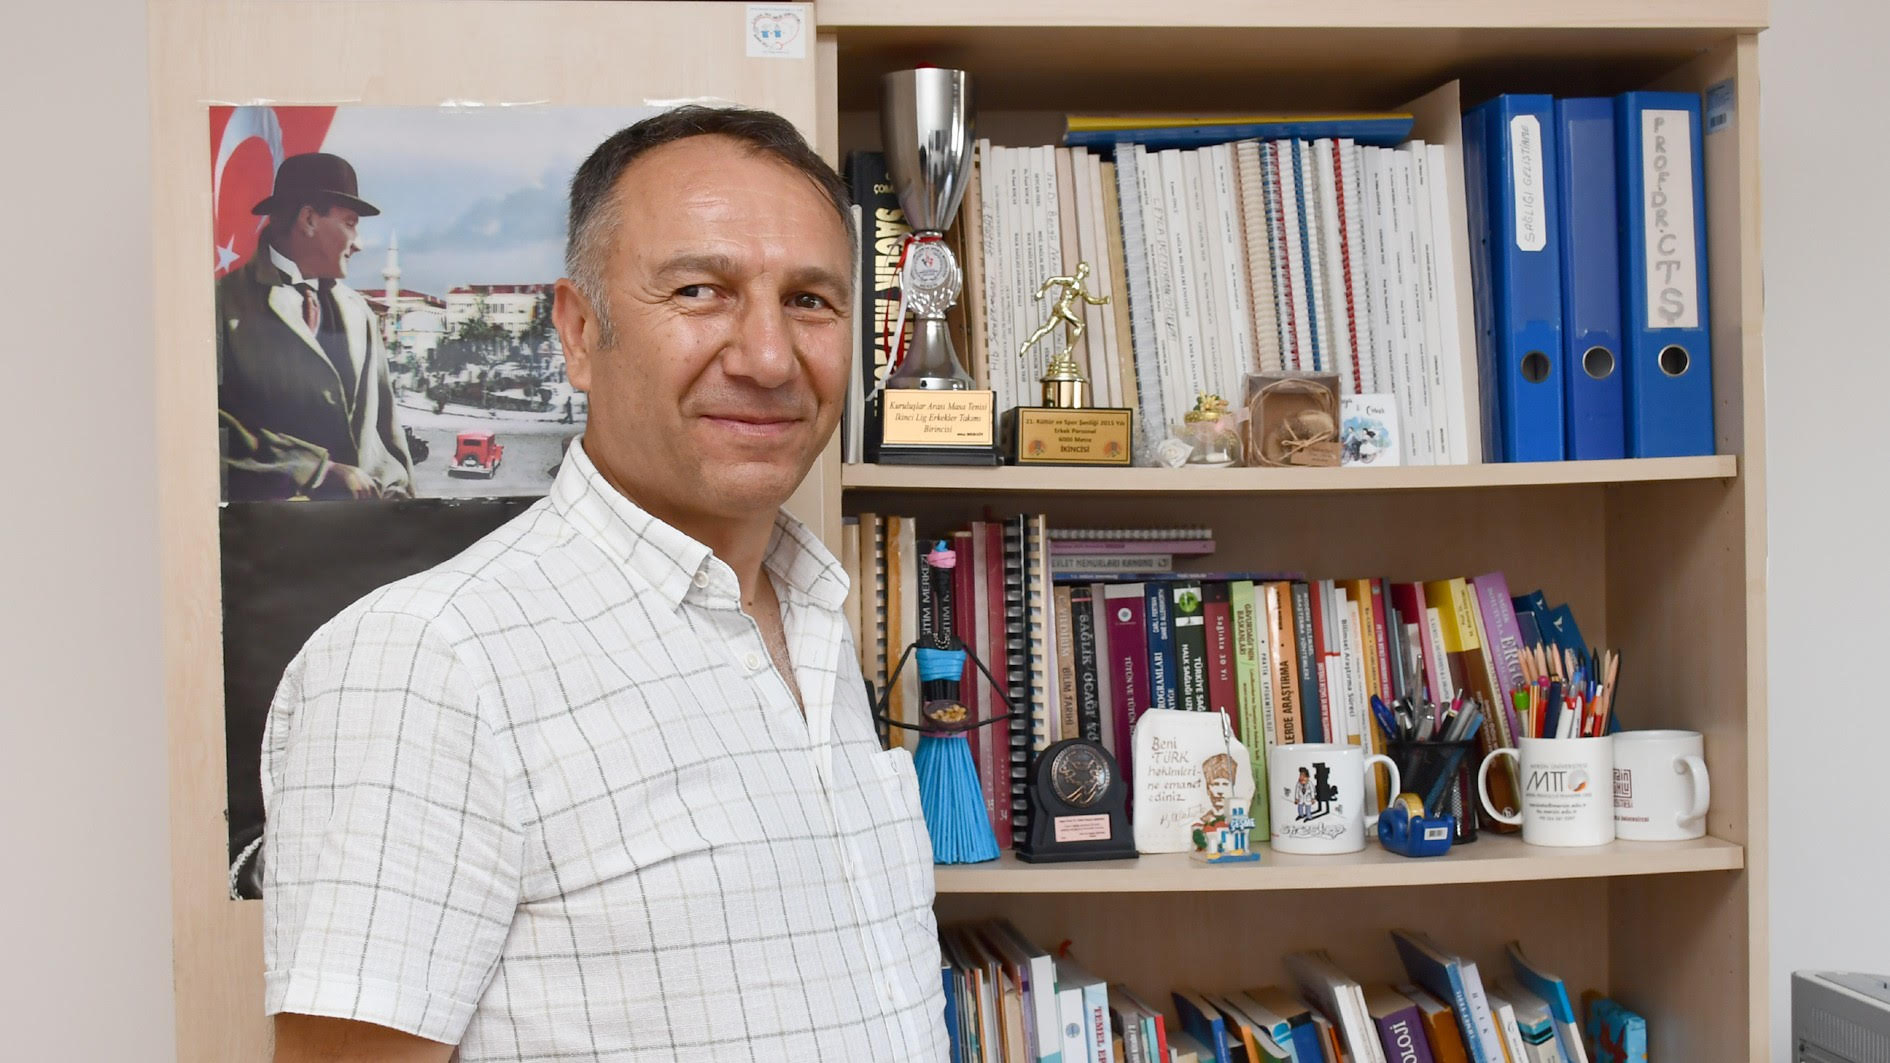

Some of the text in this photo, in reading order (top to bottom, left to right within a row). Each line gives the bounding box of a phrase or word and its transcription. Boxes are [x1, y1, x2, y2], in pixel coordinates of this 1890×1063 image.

[1182, 643, 1190, 665] HALK
[1341, 619, 1356, 717] Bilimsel Araştırma Süreci
[1183, 665, 1193, 695] SAĞLIĞI
[1193, 656, 1204, 693] TÜRKİYE
[1279, 660, 1294, 714] ARAŞTIRMA
[1152, 736, 1177, 751] Beni
